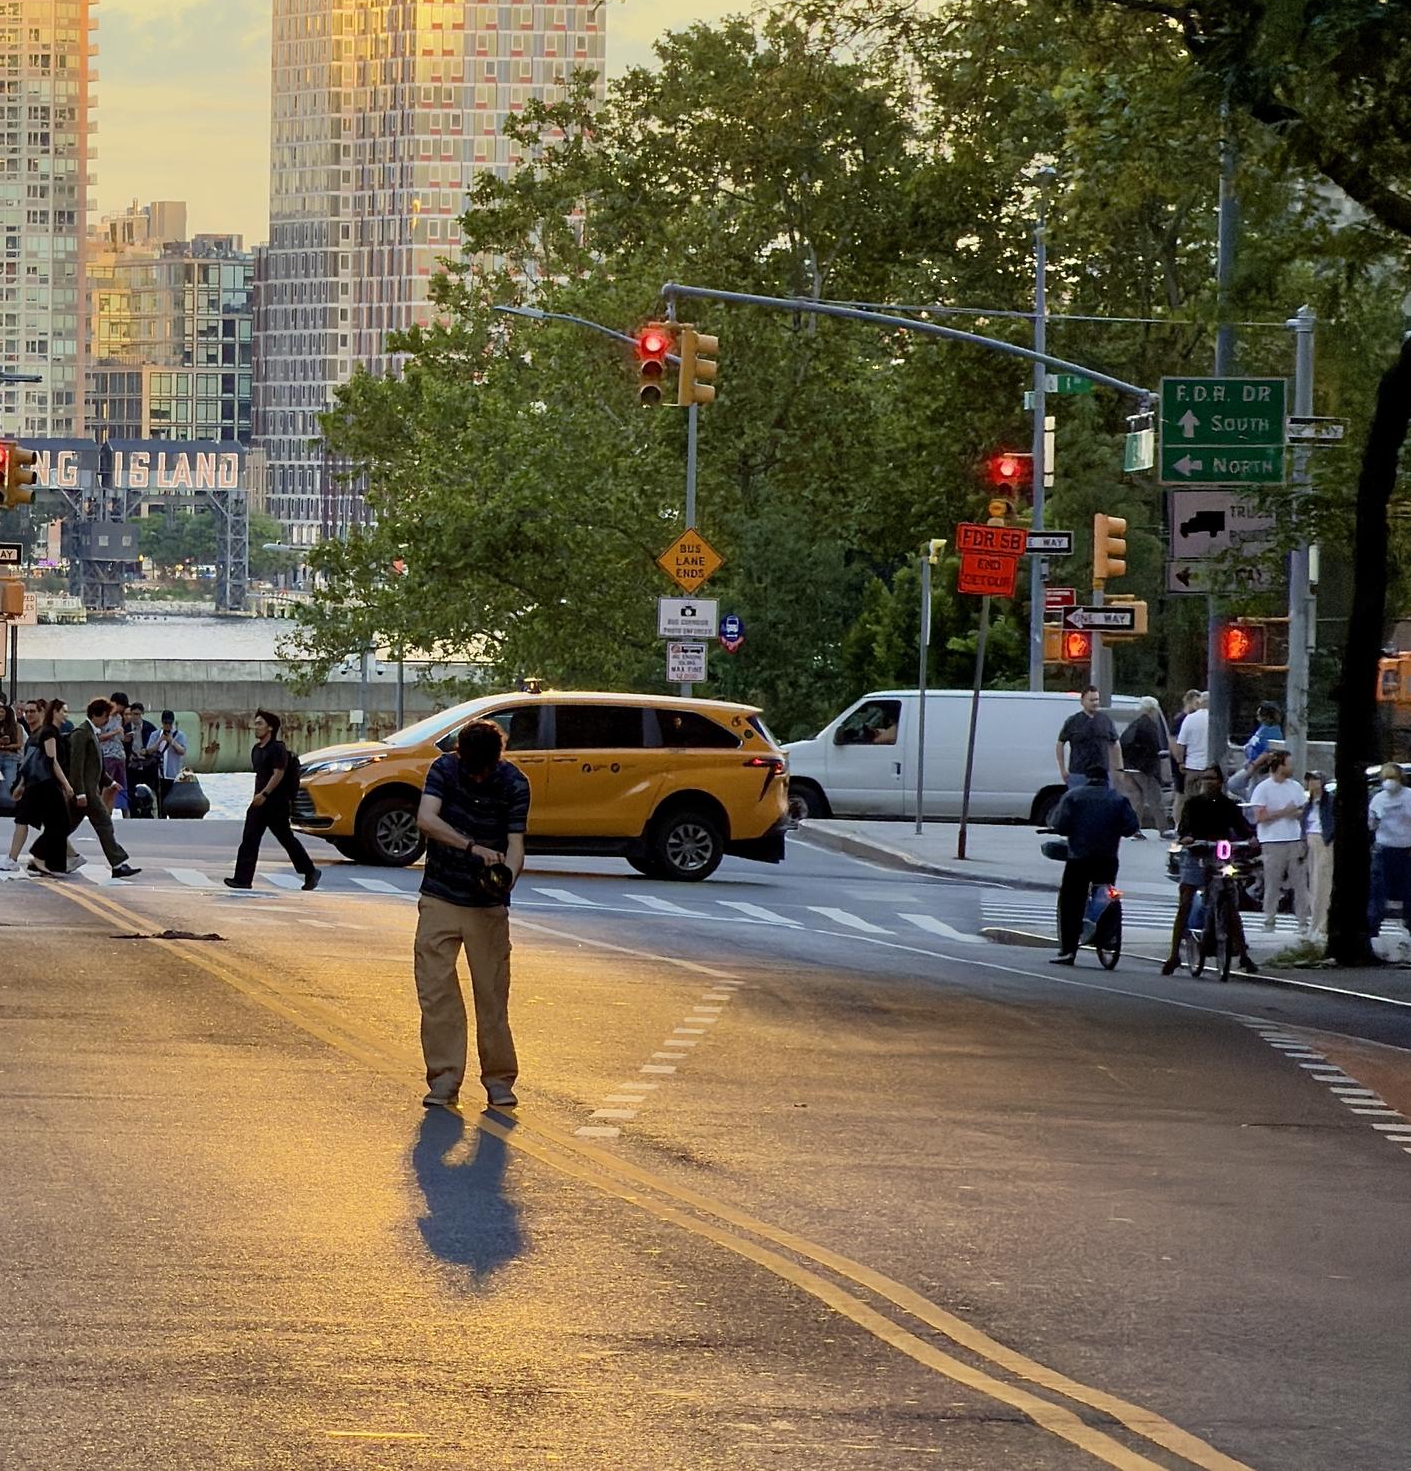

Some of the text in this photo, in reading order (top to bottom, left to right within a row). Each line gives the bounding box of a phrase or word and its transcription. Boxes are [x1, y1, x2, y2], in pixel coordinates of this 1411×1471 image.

[1242, 386, 1271, 402] DR
[32, 450, 239, 488] NG ISLAND
[963, 529, 994, 547] FDR
[1001, 534, 1021, 549] SB
[1043, 537, 1064, 546] WAY
[680, 544, 701, 553] BUS
[676, 557, 705, 566] LANE
[676, 569, 705, 578] ENDS
[1104, 614, 1125, 623] WAY
